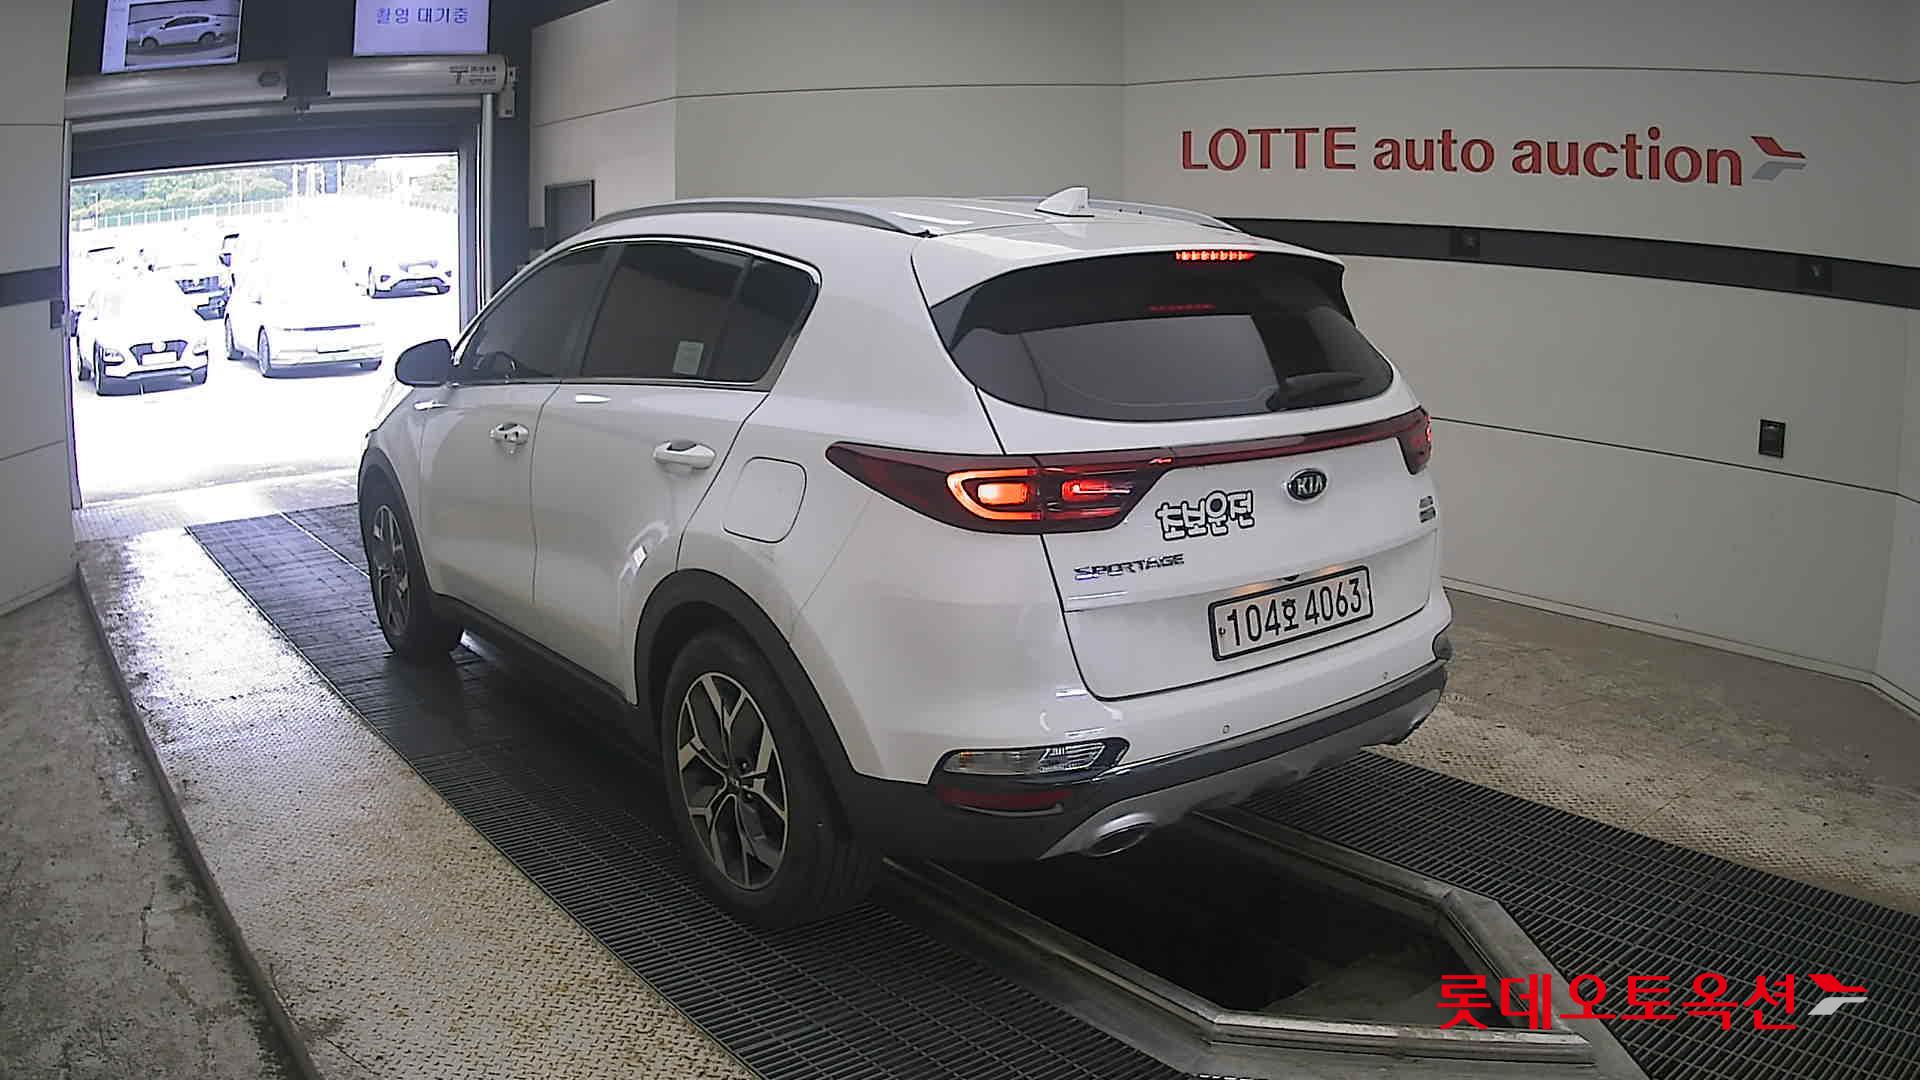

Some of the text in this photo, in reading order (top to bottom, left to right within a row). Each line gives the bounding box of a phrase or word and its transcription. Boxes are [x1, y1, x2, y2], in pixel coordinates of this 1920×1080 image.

[377, 7, 468, 24] 촬영 대기중
[1181, 126, 1742, 186] LOTTE auto auction
[1155, 490, 1255, 541] 초보운전
[1073, 553, 1185, 581] SPORTAGE
[1227, 578, 1362, 646] 104호 4063
